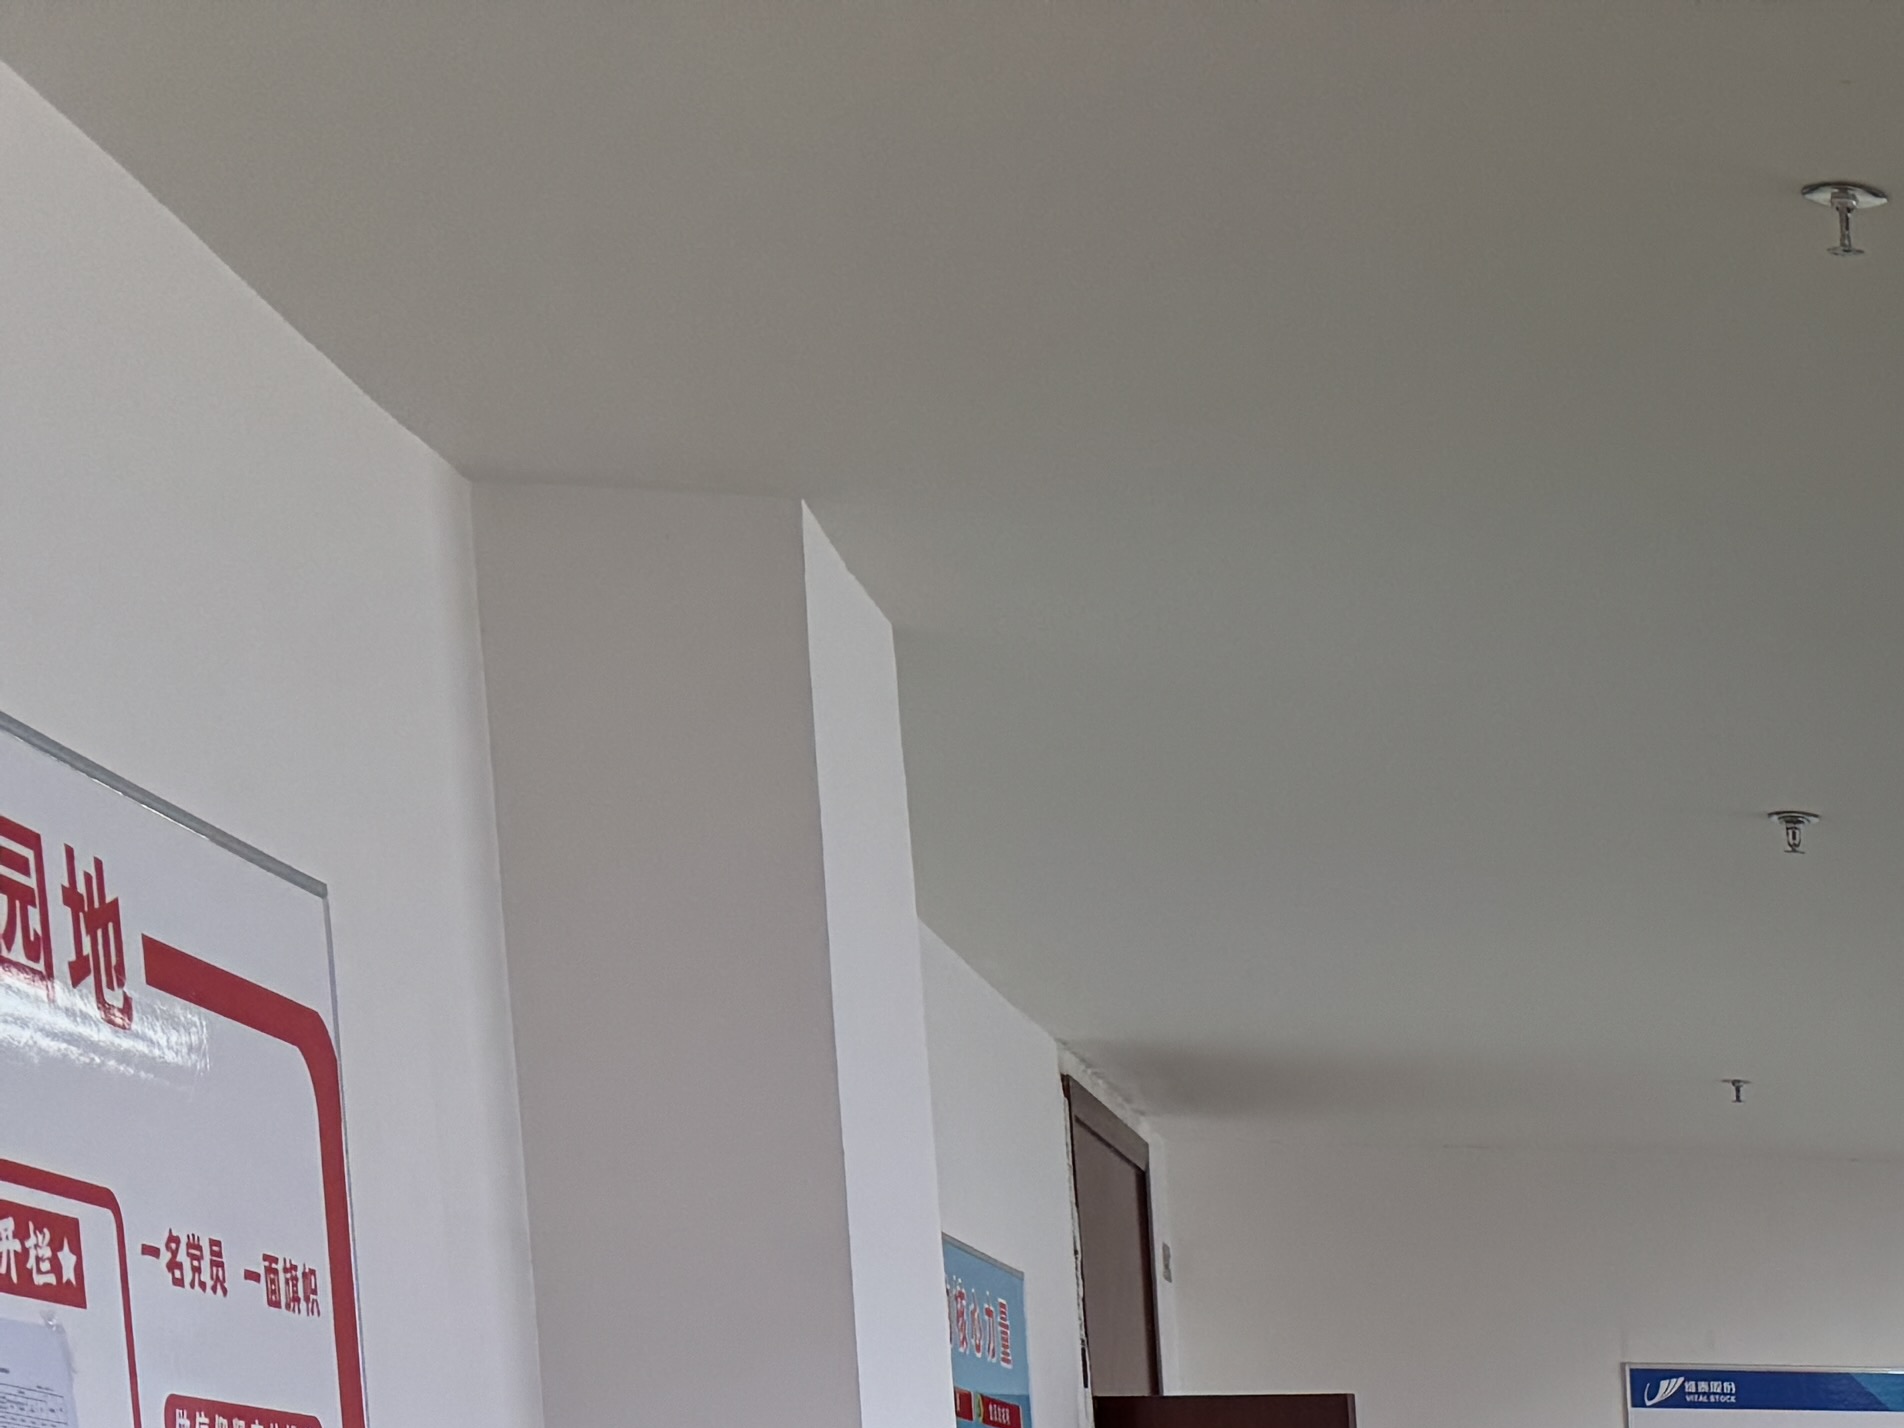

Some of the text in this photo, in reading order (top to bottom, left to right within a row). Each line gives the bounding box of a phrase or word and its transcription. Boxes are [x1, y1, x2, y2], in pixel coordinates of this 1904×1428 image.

[140, 1227, 321, 1318] 一名党员 一面旗帜
